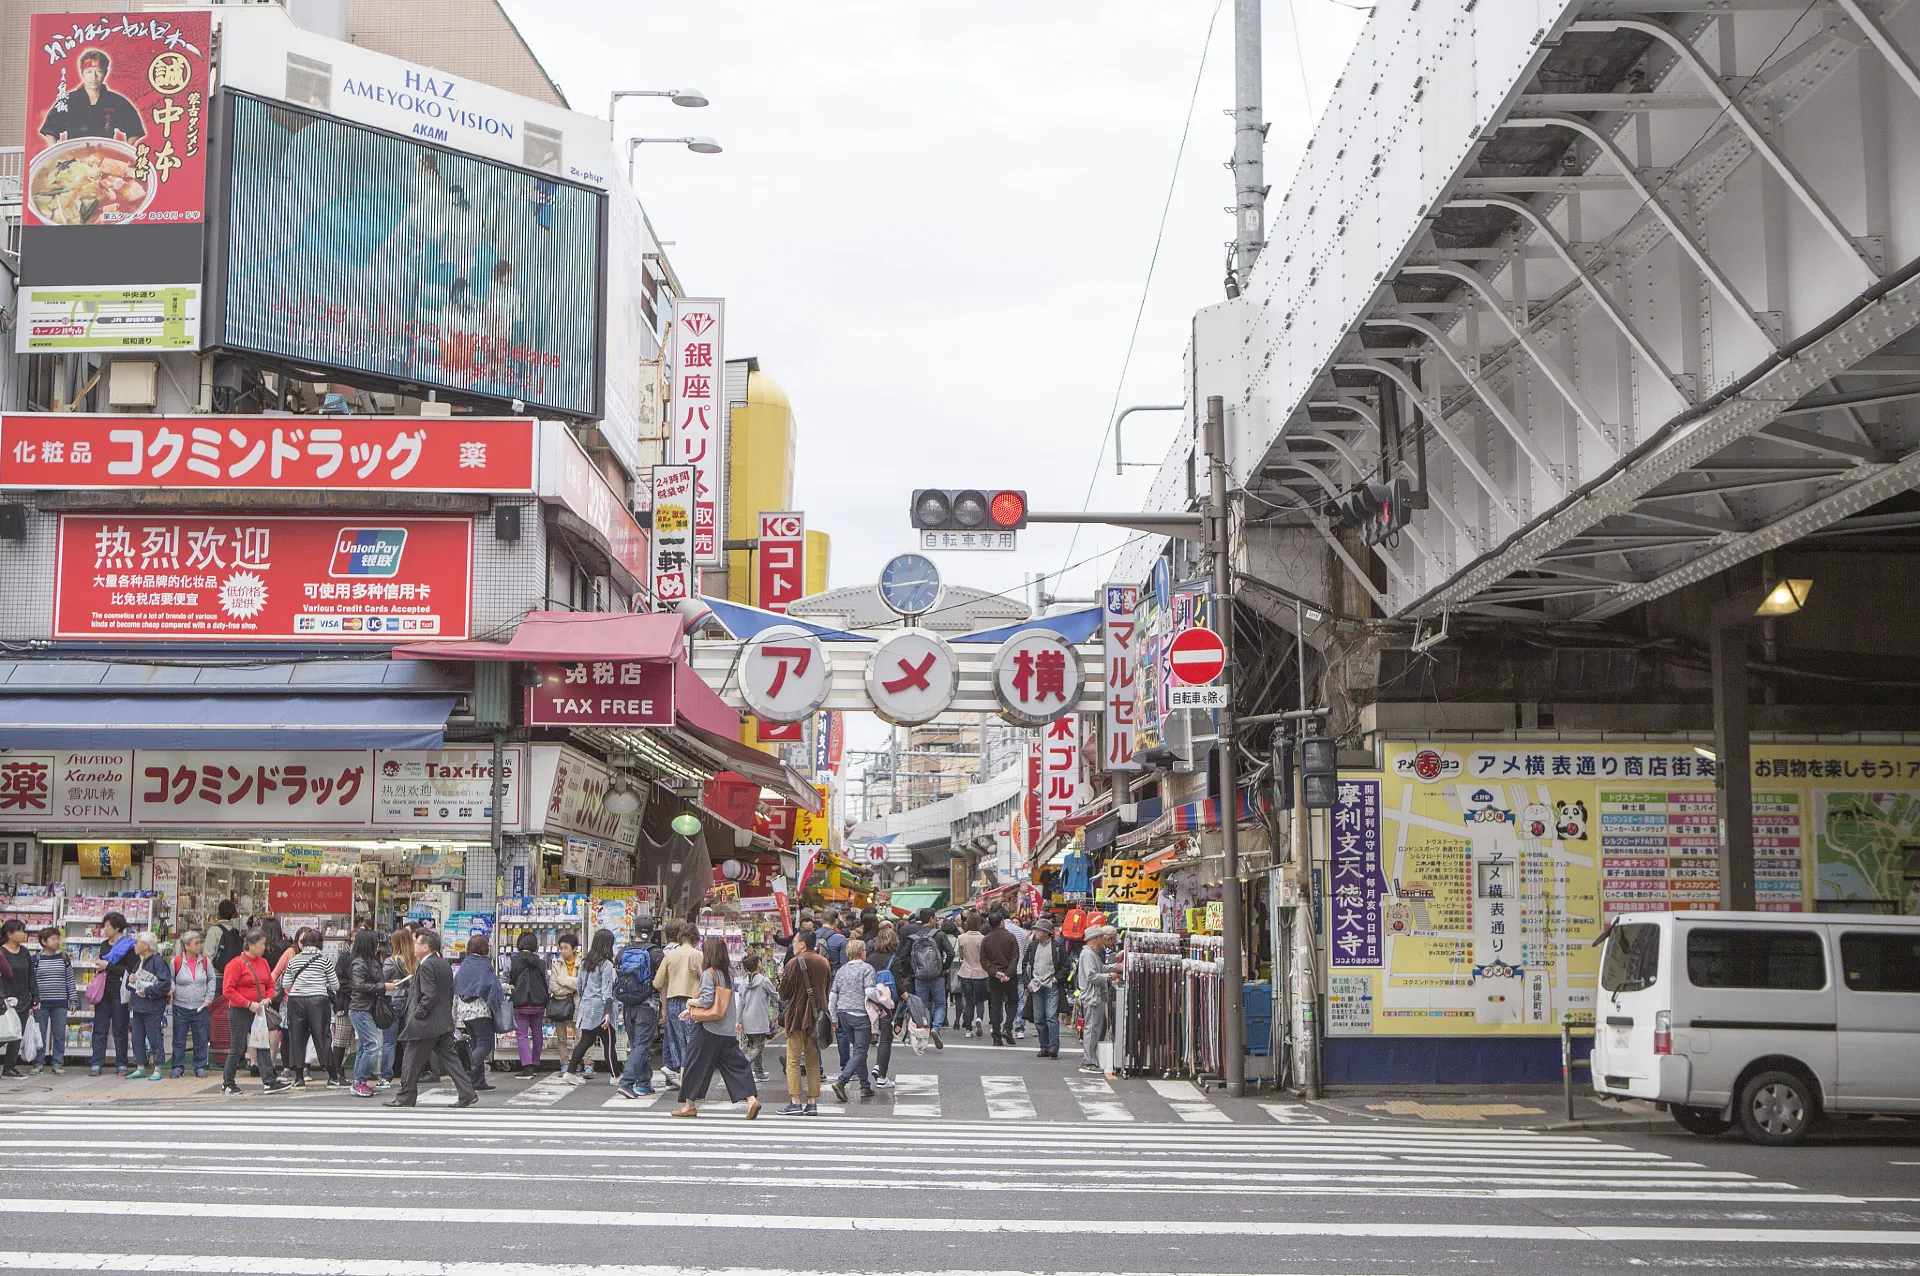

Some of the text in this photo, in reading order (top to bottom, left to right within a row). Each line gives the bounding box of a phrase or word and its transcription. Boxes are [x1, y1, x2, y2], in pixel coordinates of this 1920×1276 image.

[343, 78, 514, 139] AMEYOKO VISION
[186, 92, 202, 157] 蒙古タンメン
[412, 122, 448, 142] AKAMI
[151, 98, 184, 183] 中本
[122, 291, 156, 299] 中央通り
[12, 426, 488, 480] 化粧品 コクミンドラッグ 薬
[656, 470, 690, 488] 24時間
[763, 517, 801, 537] KG
[94, 525, 271, 570] 热烈欢迎
[926, 532, 1012, 548] 自転車専用
[339, 541, 400, 559] UnionPay
[361, 554, 393, 567] 银联
[93, 574, 218, 589] 大量各种品牌的化妆品
[111, 592, 199, 606] 比免税店要便宜
[226, 586, 262, 597] 低价格
[303, 582, 431, 600] 可使用多种信用卡
[231, 598, 255, 609] 提供
[303, 604, 431, 614] Various Credit Cards Accepted
[91, 612, 102, 620] The
[135, 612, 142, 620] of
[148, 612, 156, 620] lot
[158, 612, 165, 620] of
[165, 612, 187, 620] brands
[188, 612, 195, 620] of
[195, 612, 217, 620] various
[320, 620, 339, 628] VISA
[91, 621, 108, 630] kinds
[109, 621, 116, 630] of
[116, 621, 141, 630] become
[141, 621, 160, 630] cheap
[161, 621, 191, 630] compared
[192, 621, 206, 630] with
[212, 621, 240, 630] duty-free
[565, 662, 642, 685] 免税店
[1108, 621, 1135, 764] マルセル
[1172, 691, 1224, 704] 自転車を除く
[553, 698, 654, 715] TAX FREE
[63, 754, 123, 765] SHISEIDO
[64, 769, 123, 782] Kanebo
[1, 761, 49, 810] 薬
[68, 787, 116, 801] 雪肌精
[144, 765, 365, 806] コクミンドラッグ
[381, 784, 432, 797] 热烈欢迎
[63, 805, 120, 817] SOFINA
[1476, 812, 1504, 820] アメ横
[1364, 784, 1375, 873] 開運勝利の守護神
[1335, 782, 1364, 957] 摩利支天徳大寺
[1107, 882, 1159, 901] スポーツ
[1488, 852, 1506, 952] アメ横表通り
